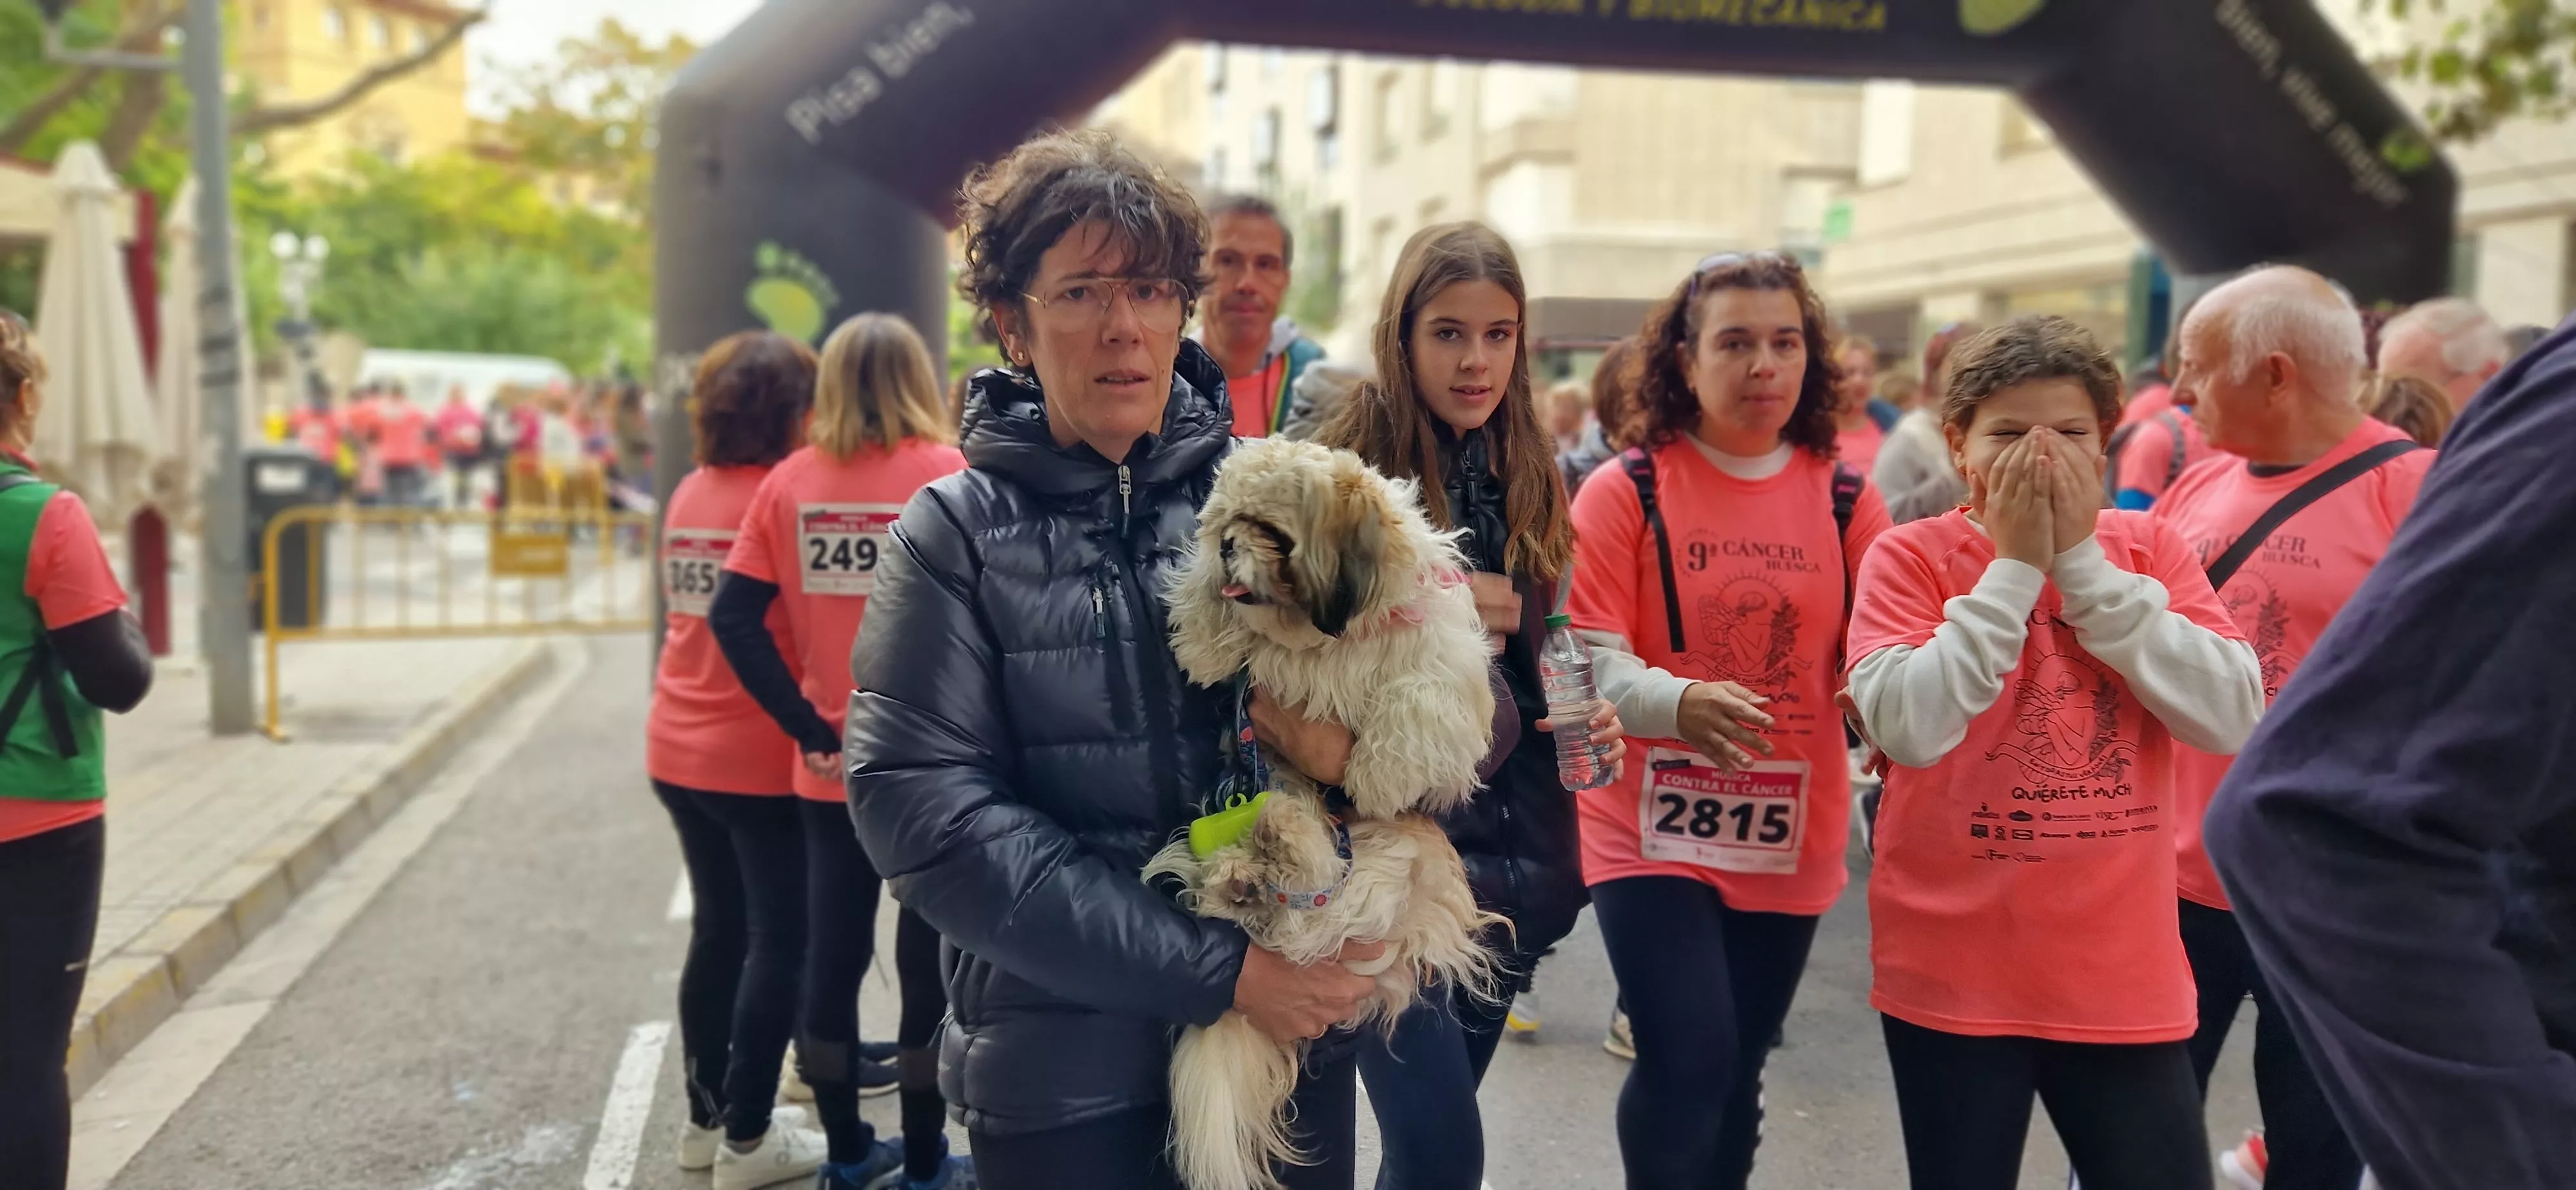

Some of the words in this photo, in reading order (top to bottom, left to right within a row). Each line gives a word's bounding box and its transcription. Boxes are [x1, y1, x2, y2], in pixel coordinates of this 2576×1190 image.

[785, 66, 883, 145] Pisa
[810, 537, 878, 572] 249
[1722, 537, 1804, 561] CÁNCER
[2262, 551, 2322, 569] HUESCA
[1766, 559, 1822, 574] HUESCA
[1662, 773, 1719, 791] CONTRA
[1723, 781, 1738, 793] EL
[1741, 782, 1793, 795] CÁNCER
[2012, 784, 2089, 803] QUIÉRETE
[2094, 783, 2133, 799] MUCH
[1655, 793, 1790, 844] 2815
